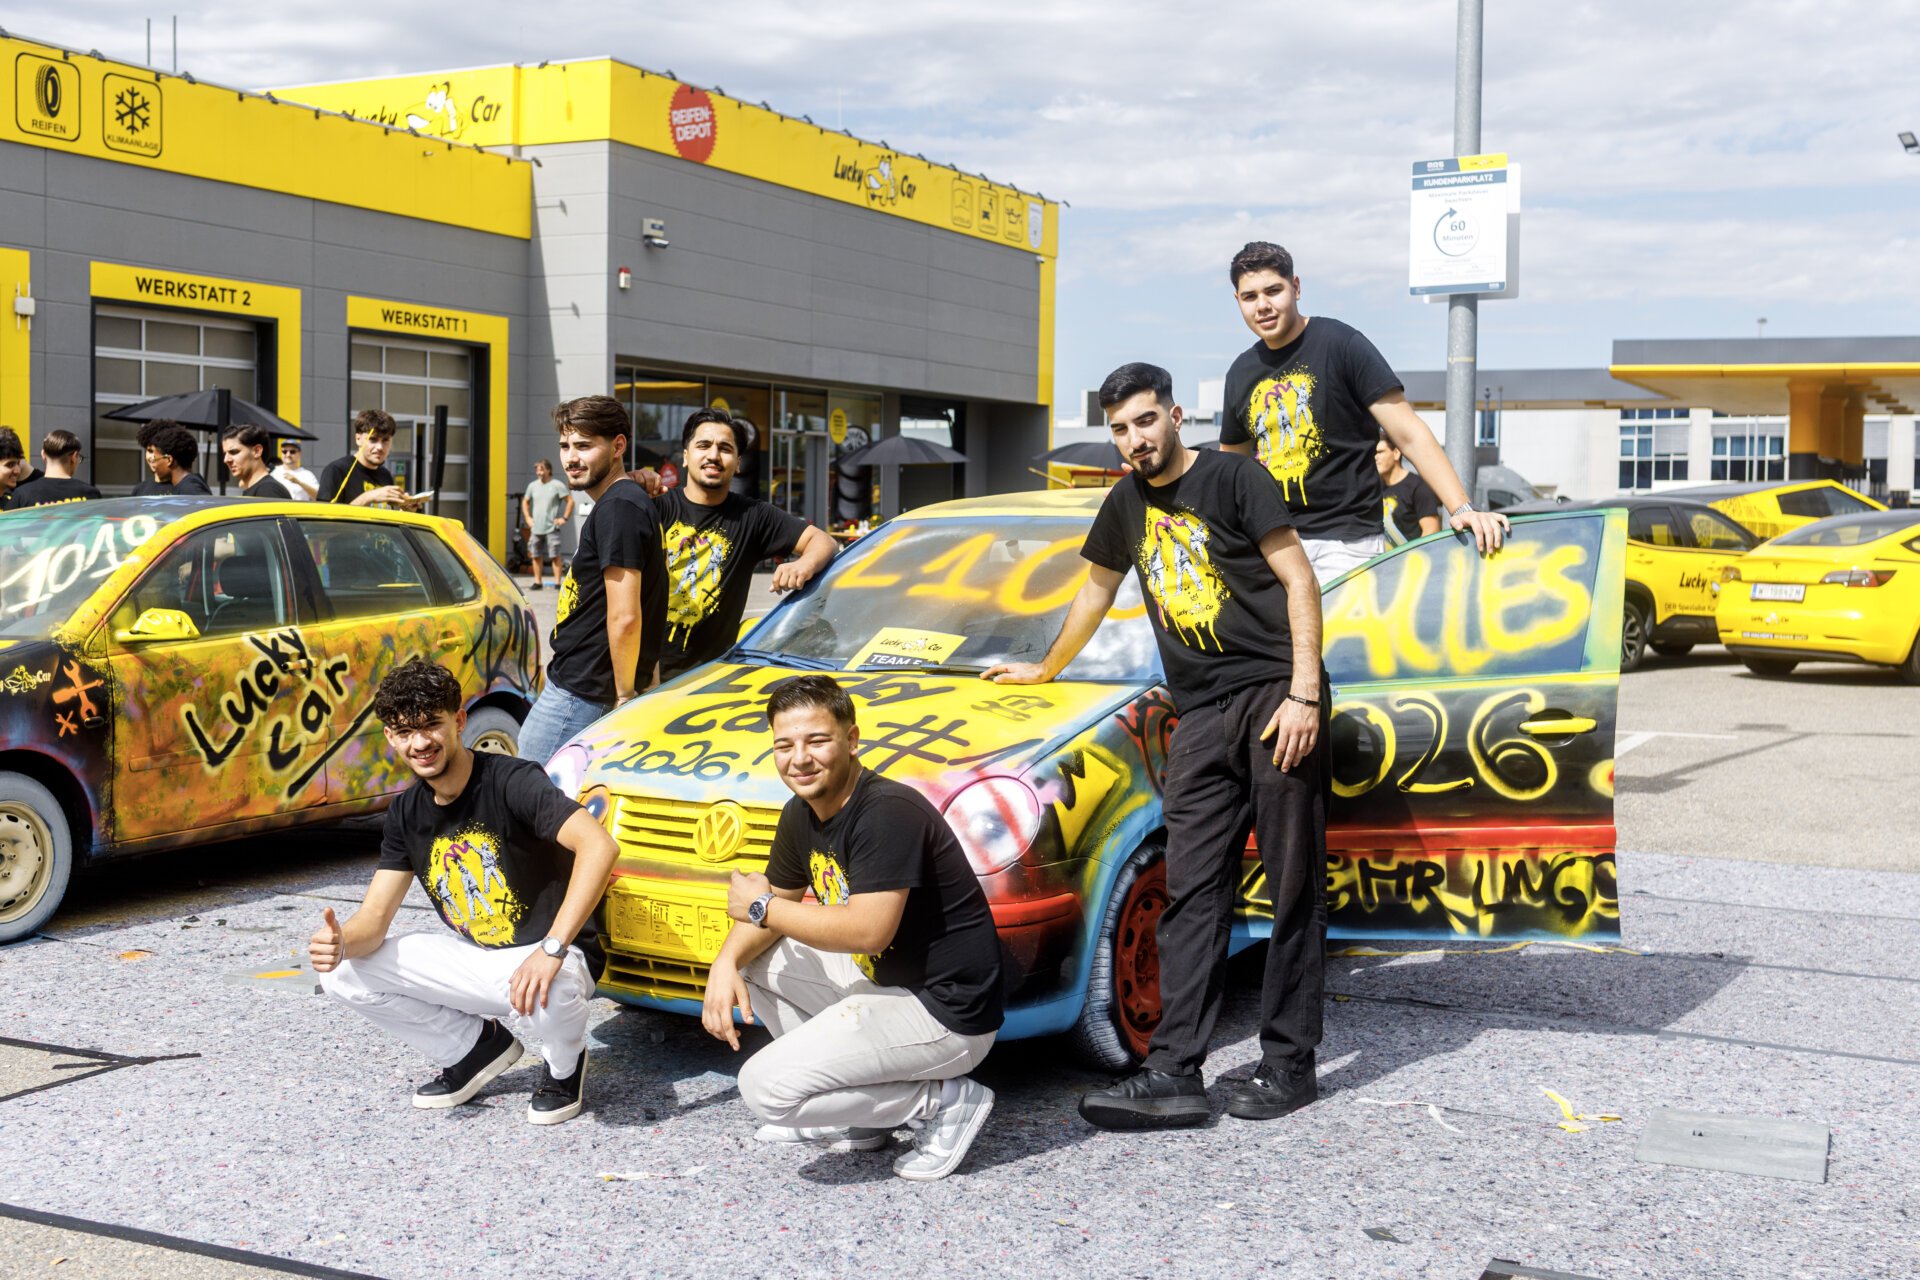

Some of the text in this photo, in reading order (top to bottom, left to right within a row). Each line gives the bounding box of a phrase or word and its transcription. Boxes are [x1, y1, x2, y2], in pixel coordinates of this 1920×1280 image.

[471, 95, 502, 123] Car
[671, 105, 712, 126] REIFEN-
[31, 118, 67, 135] REIFEN
[675, 122, 712, 142] DEPOT
[107, 134, 159, 151] KLIMAANLAGE
[834, 155, 917, 199] Lucky Car
[1423, 173, 1494, 187] KUNDENPARKPLATZ
[1450, 220, 1466, 232] 60
[1442, 233, 1474, 242] Minuten
[135, 276, 251, 306] WERKSTATT 2
[381, 308, 468, 333] WERKSTATT 1
[0, 514, 157, 613] 1010
[1680, 571, 1707, 594] Lucky
[1321, 542, 1592, 678] ALLES
[879, 638, 942, 652] Lucky Car
[869, 653, 909, 665] TEAM
[36, 669, 51, 683] Car
[184, 627, 313, 768] Lucky
[268, 660, 348, 772] Car
[663, 699, 770, 735] Ca
